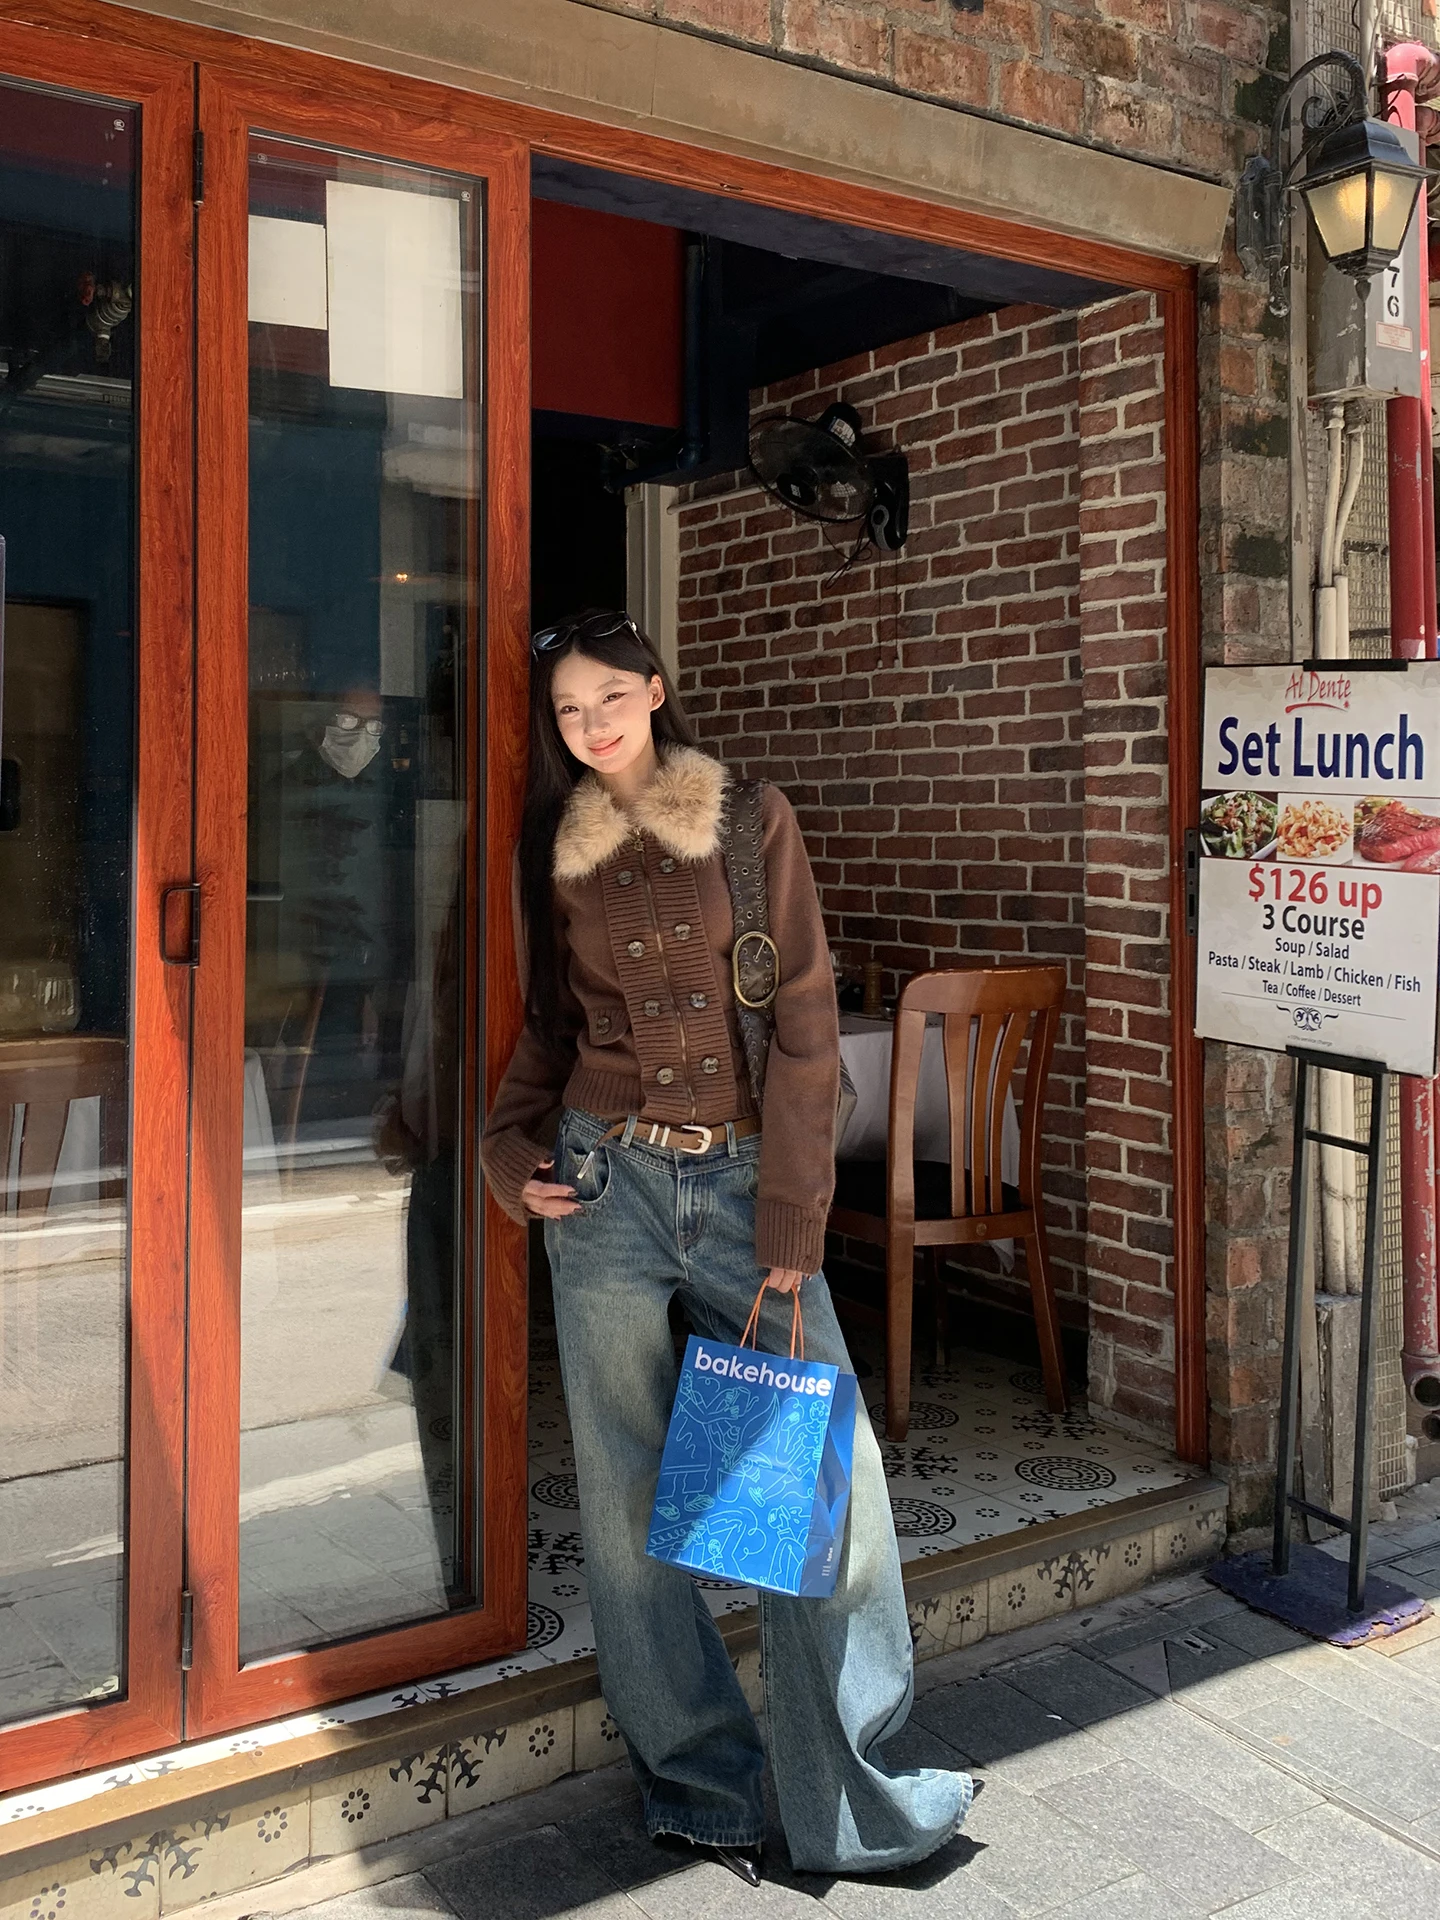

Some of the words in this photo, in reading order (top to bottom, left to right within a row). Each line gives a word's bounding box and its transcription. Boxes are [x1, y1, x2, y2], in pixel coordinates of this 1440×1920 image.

[1285, 672, 1304, 699] Al
[1306, 671, 1352, 702] Dente
[1218, 716, 1281, 777] Set
[1293, 714, 1424, 780] Lunch
[1248, 863, 1328, 905] $126
[1338, 880, 1383, 918] up
[1262, 904, 1275, 930] 3
[1282, 905, 1365, 940] Course
[1275, 937, 1306, 957] Soup
[1315, 942, 1350, 960] Salad
[1208, 951, 1239, 969] Pasta
[1248, 956, 1281, 974] Steak
[1290, 961, 1324, 980] Lamb
[1334, 967, 1384, 988] Chicken
[1394, 974, 1421, 993] Fish
[1262, 980, 1278, 995] Tea
[1285, 983, 1316, 1000] Coffee
[1324, 988, 1361, 1007] Dessert
[694, 1346, 832, 1397] bakehouse
